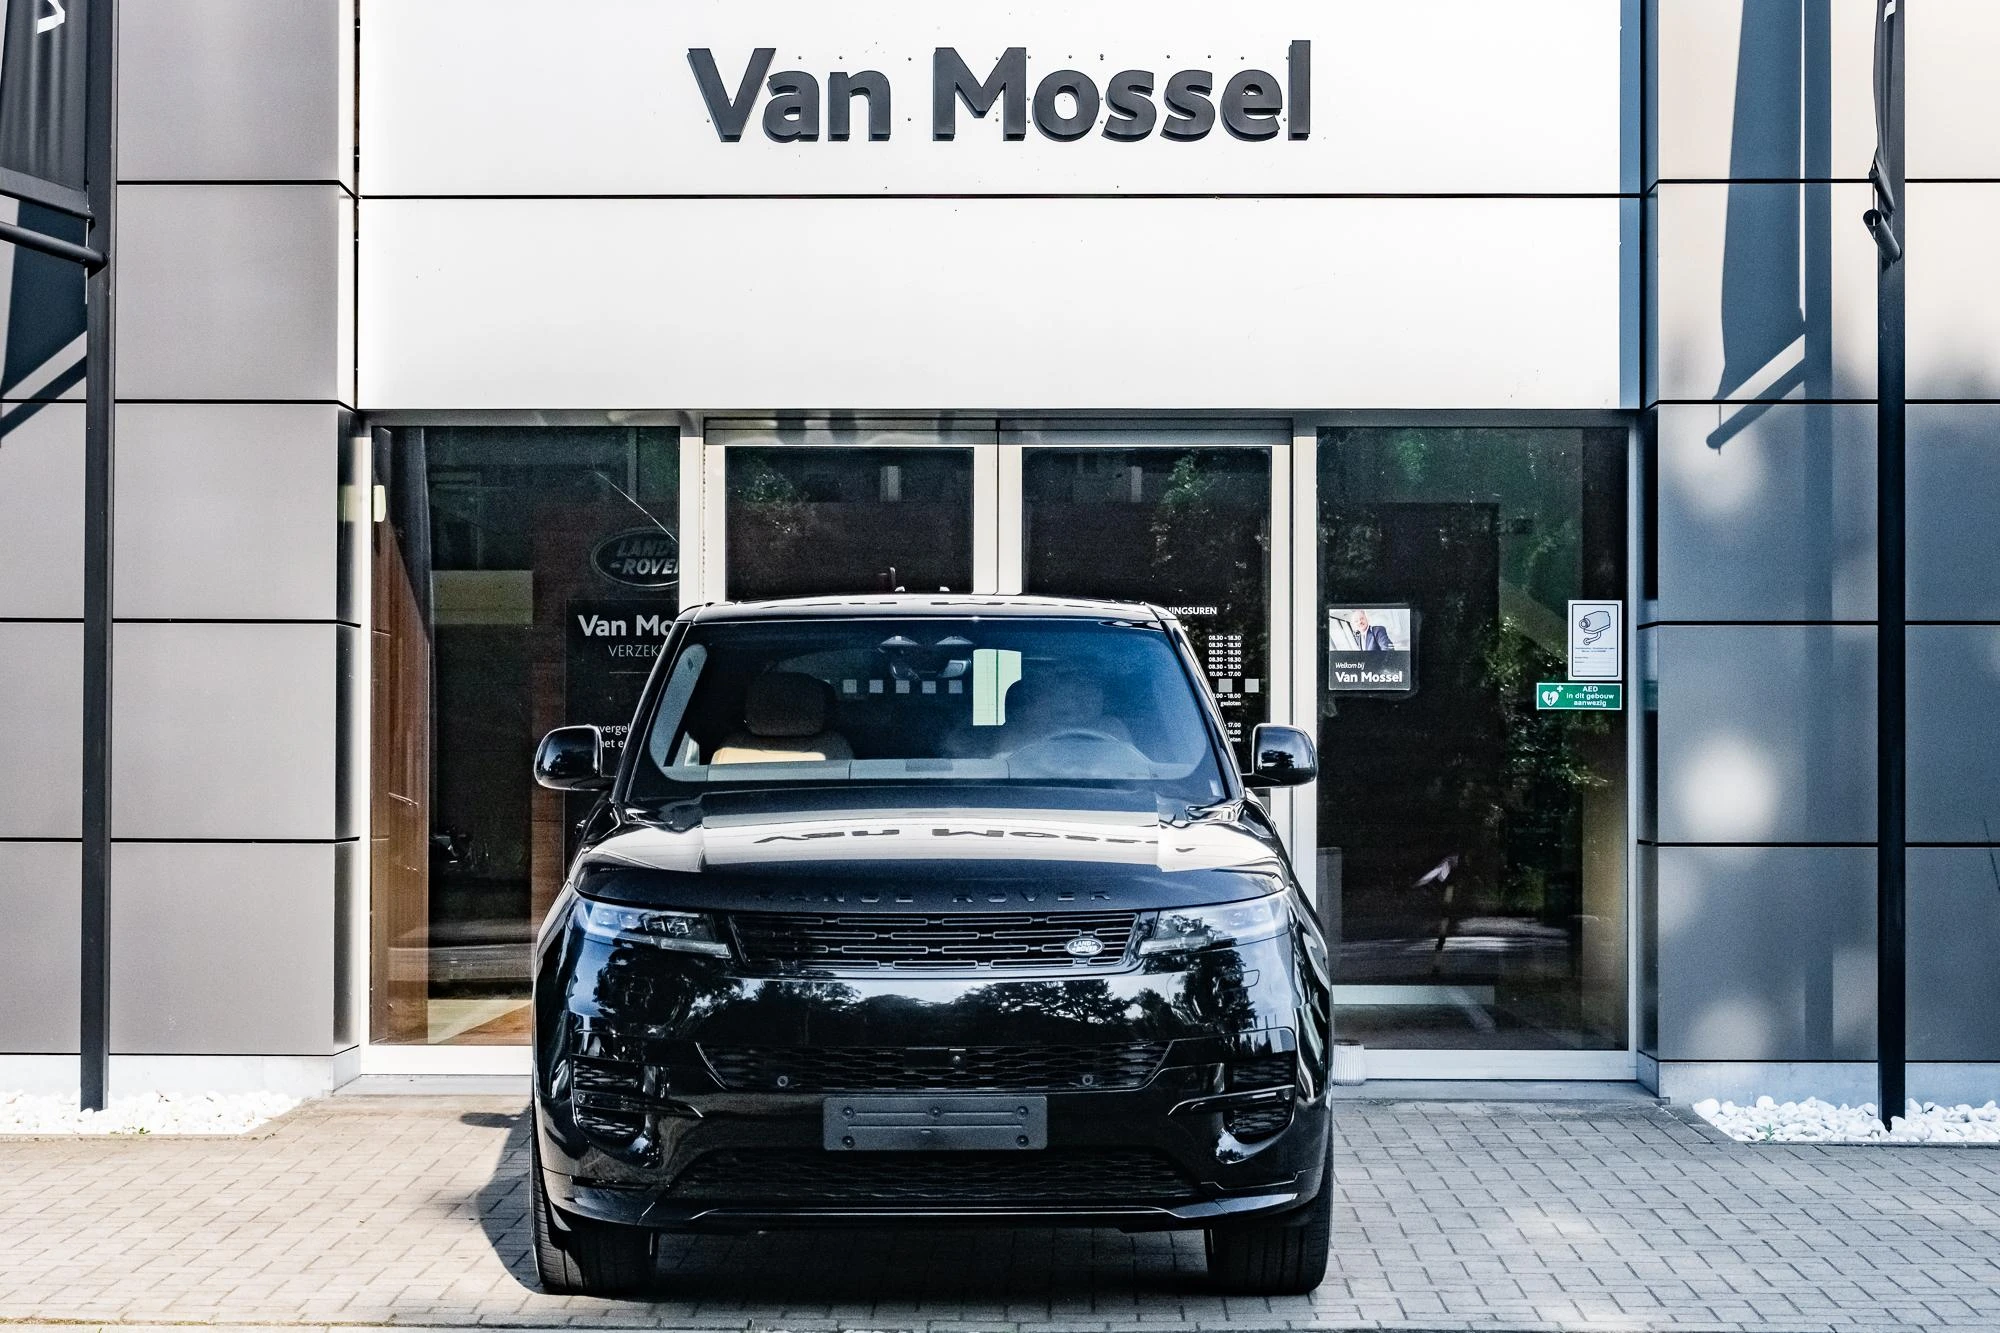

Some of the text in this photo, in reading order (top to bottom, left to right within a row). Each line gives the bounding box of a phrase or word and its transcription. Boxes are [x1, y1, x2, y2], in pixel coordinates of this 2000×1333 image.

[687, 39, 1311, 142] Van Mossel
[577, 614, 627, 637] Van
[1335, 670, 1403, 683] Van Mossel
[1582, 685, 1599, 693] AED
[1586, 692, 1615, 701] gebouw
[1573, 699, 1607, 708] aanwezig
